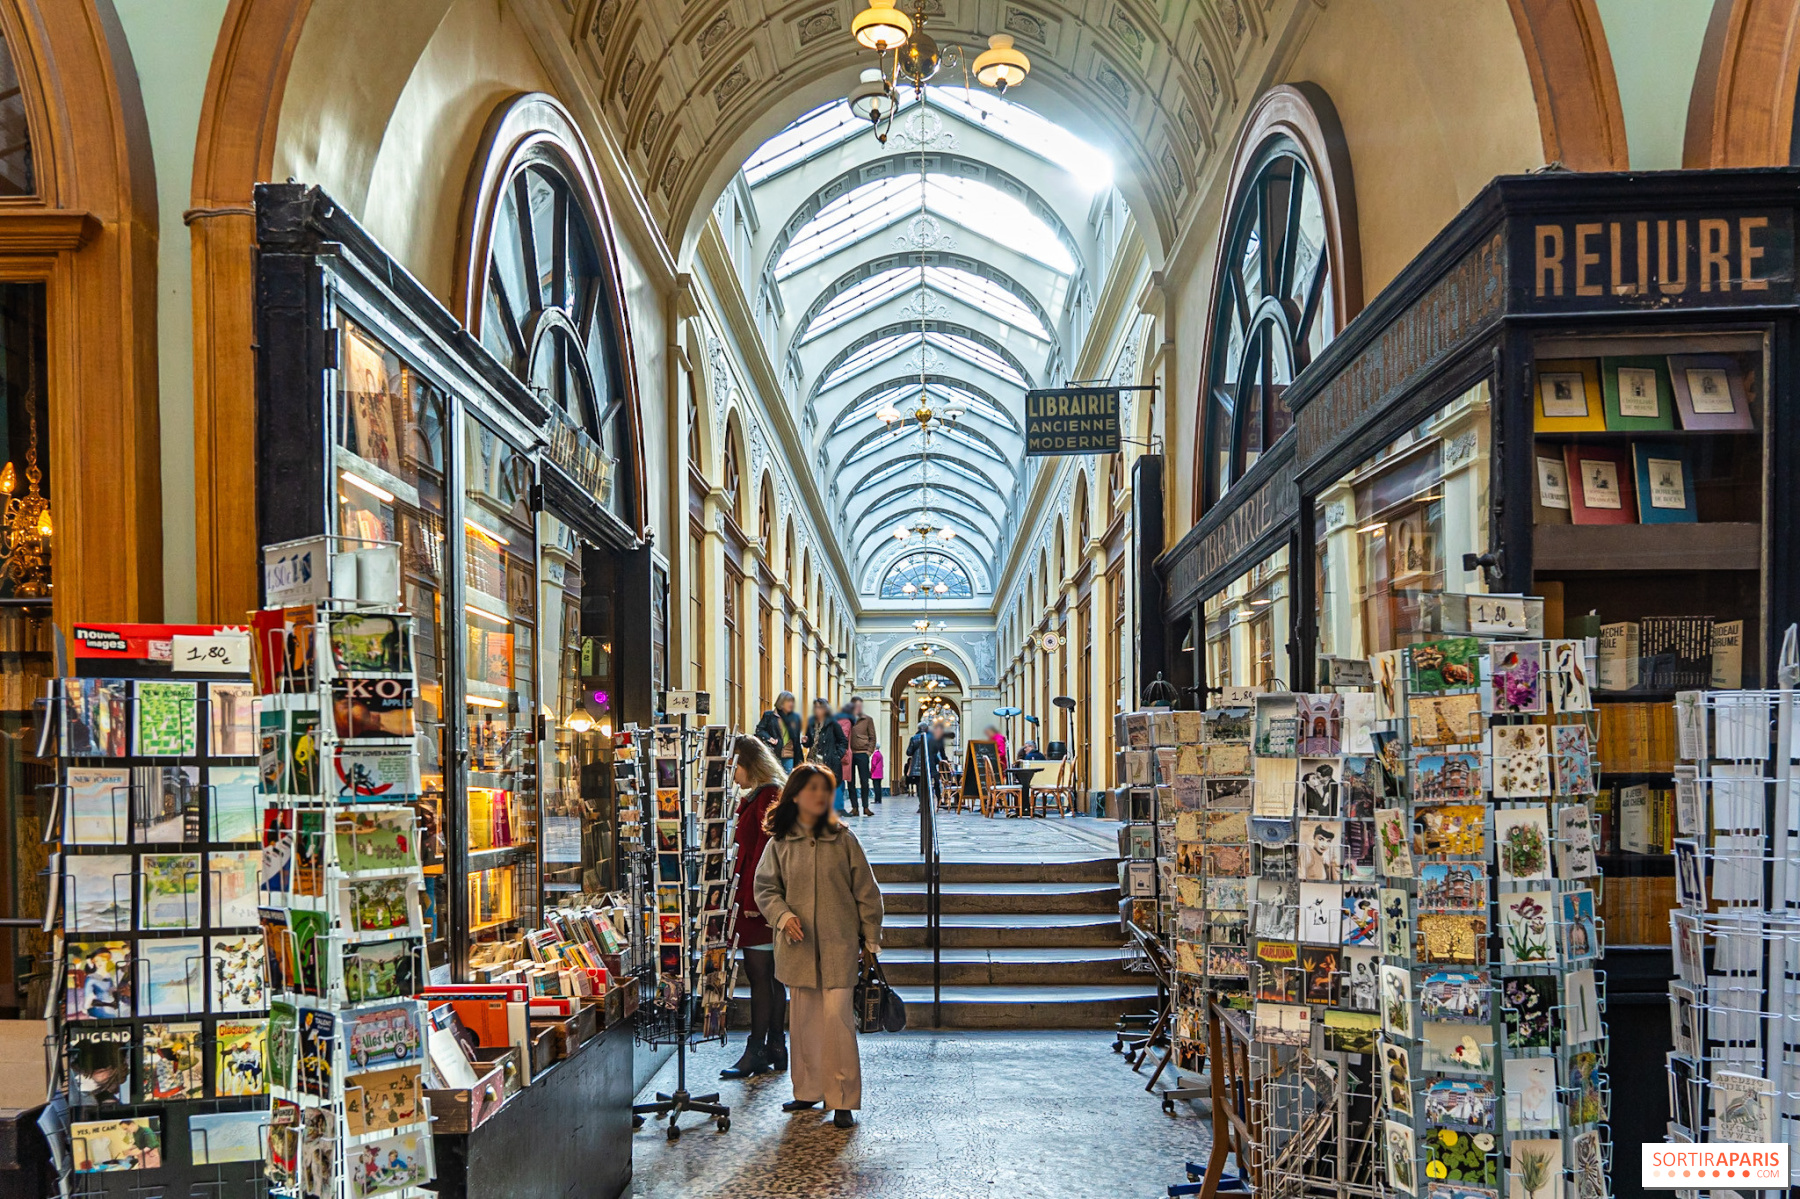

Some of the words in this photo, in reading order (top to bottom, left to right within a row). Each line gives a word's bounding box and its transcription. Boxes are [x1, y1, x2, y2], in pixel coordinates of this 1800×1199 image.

[1534, 216, 1769, 298] RELIURE
[1028, 393, 1116, 418] LIBRAIRIE
[1029, 418, 1116, 434] ANCIENNE
[1029, 434, 1116, 450] MODERNE
[550, 416, 609, 503] IBRAIRIE
[1197, 480, 1273, 582] LIBRAIRIE
[86, 639, 127, 650] images
[382, 698, 413, 707] APPLS
[73, 776, 90, 784] NEW
[93, 775, 123, 785] YORKER
[1259, 945, 1295, 960] MARIJUANA
[362, 1033, 382, 1048] Alles
